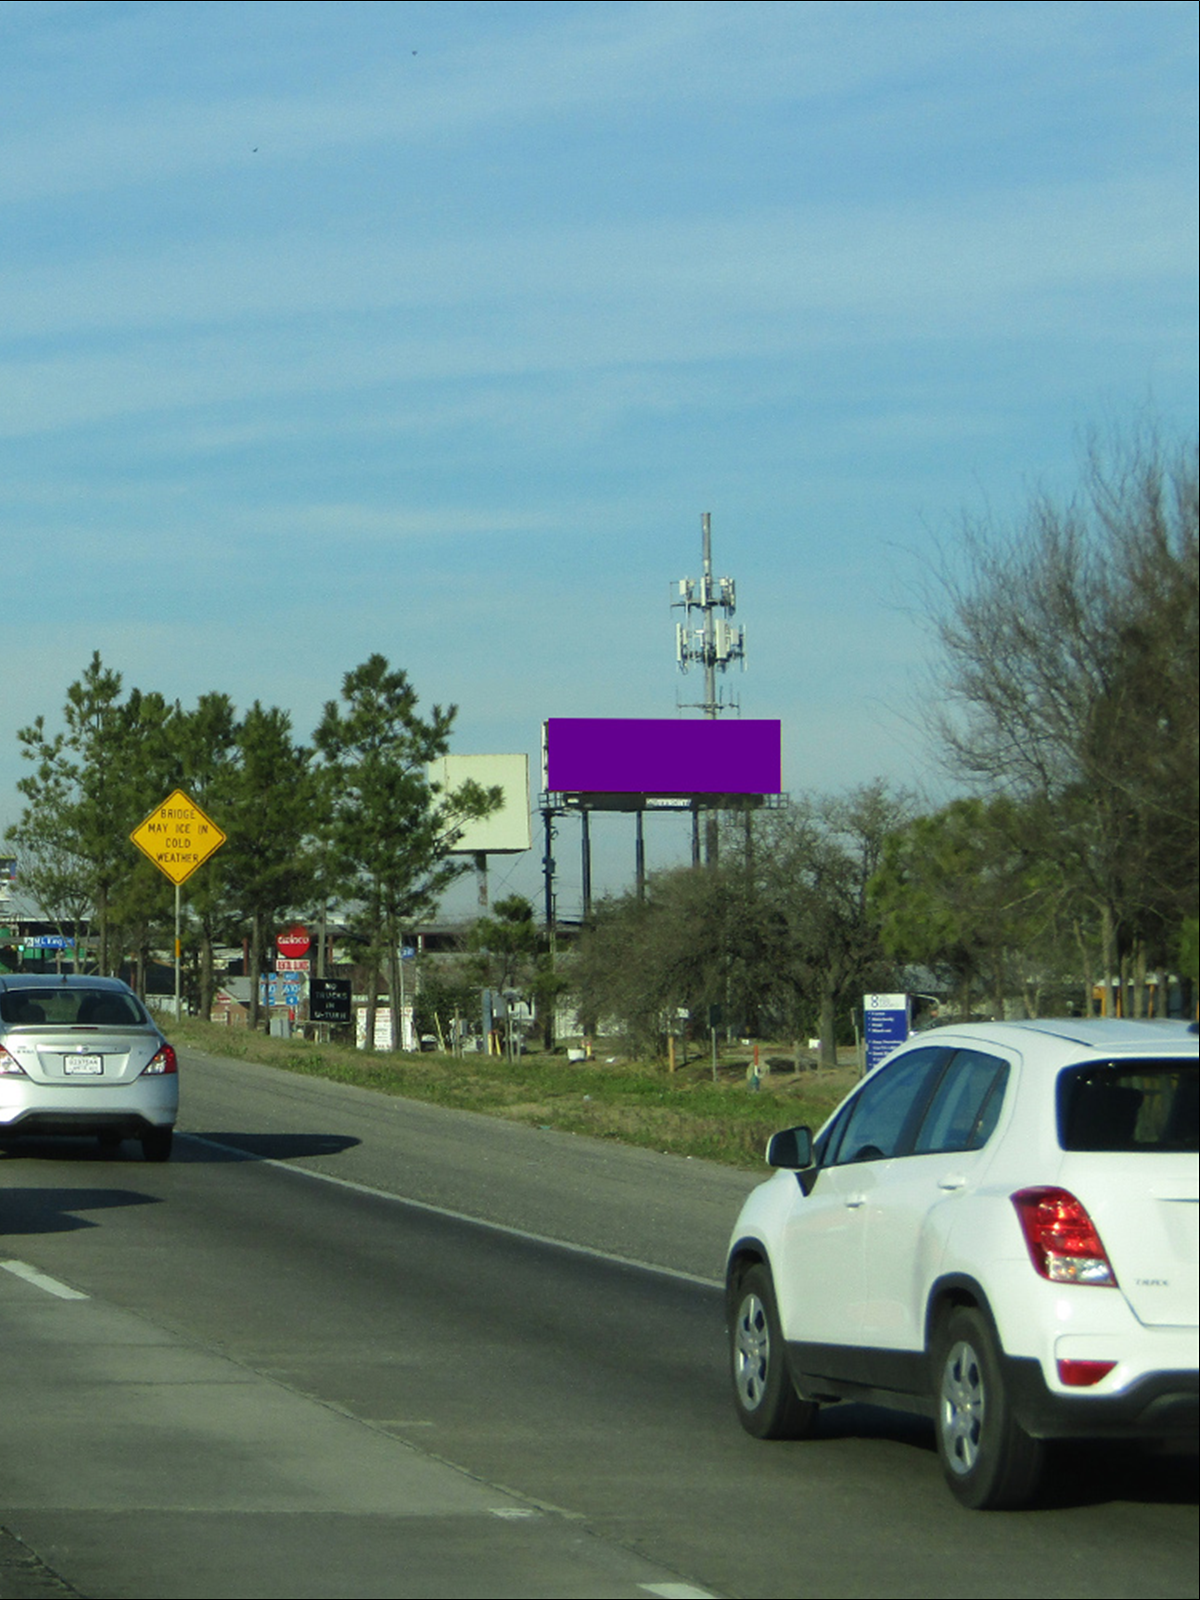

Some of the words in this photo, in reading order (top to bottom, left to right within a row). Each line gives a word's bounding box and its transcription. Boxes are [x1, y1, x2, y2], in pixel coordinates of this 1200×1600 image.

[160, 808, 195, 819] BRIDGE
[148, 823, 168, 833] MAY
[175, 823, 191, 834] ICE
[198, 824, 208, 835] IN
[165, 837, 191, 848] COLD
[156, 852, 199, 863] WEATHER
[325, 982, 337, 990] NO
[315, 991, 348, 1000] TRUCKS
